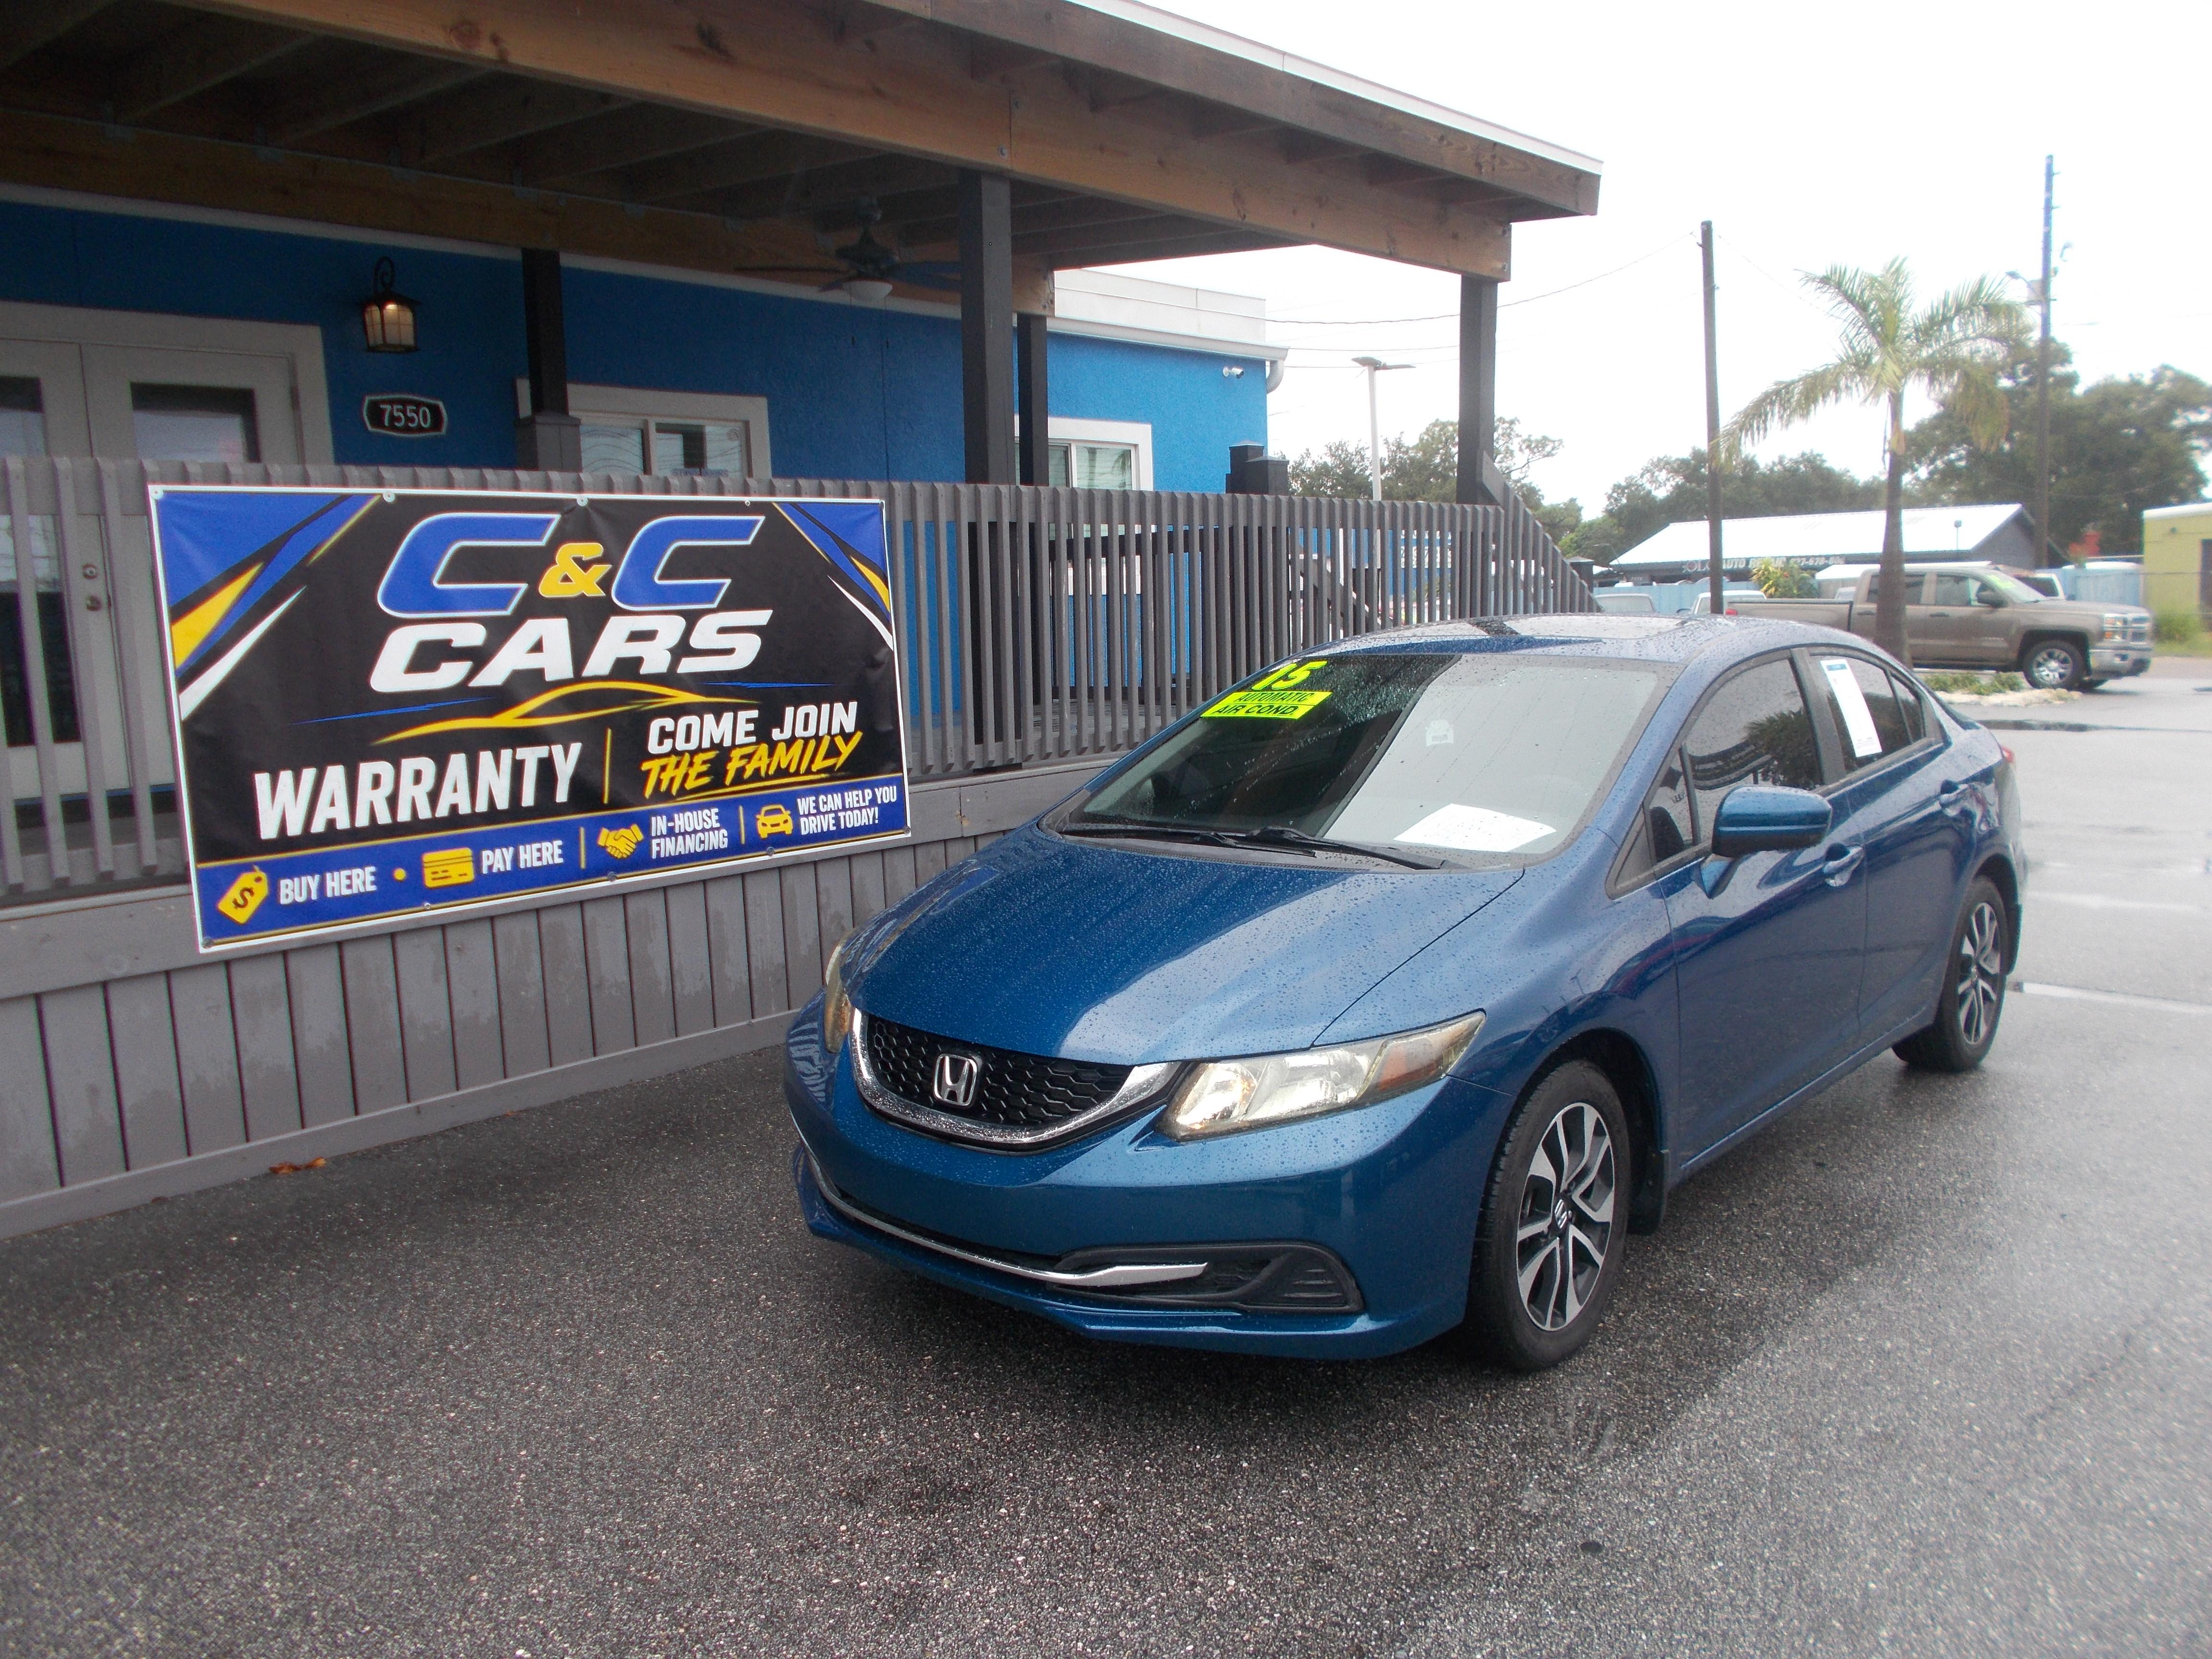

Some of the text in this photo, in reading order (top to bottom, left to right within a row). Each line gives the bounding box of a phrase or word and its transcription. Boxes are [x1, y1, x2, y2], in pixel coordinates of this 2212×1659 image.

[380, 405, 431, 428] 7550
[370, 610, 773, 692] CARS
[1251, 661, 1327, 690] 15
[1211, 705, 1244, 714] AIR
[1233, 693, 1315, 703] AUTOMATIC
[648, 701, 858, 754] COME JOIN
[641, 731, 863, 799] THE FAMILY
[254, 743, 582, 840] WARRANTY
[797, 785, 898, 815] WE CAN HELP YOU
[651, 808, 721, 837] IN-HOUSE
[800, 807, 879, 835] DRIVE TODAY!
[481, 841, 564, 874] PAY HERE
[651, 829, 728, 859] FINANCING
[279, 866, 377, 905] BUY HERE
